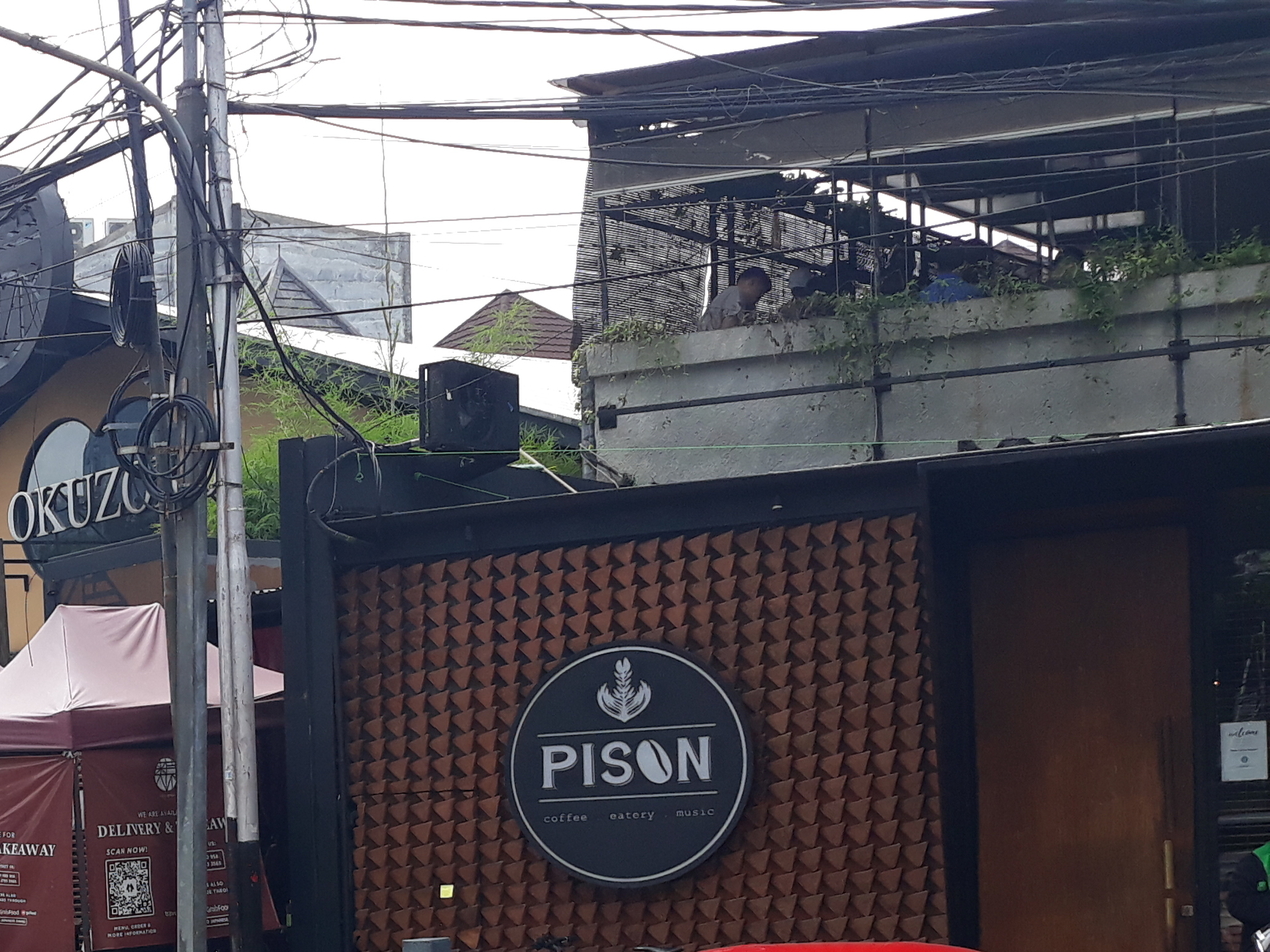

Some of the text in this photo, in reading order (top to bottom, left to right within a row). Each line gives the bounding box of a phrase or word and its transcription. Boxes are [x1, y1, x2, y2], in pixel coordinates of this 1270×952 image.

[138, 811, 147, 819] WE
[148, 810, 159, 818] ARE
[543, 806, 715, 824] coffee eatery music
[3, 831, 16, 839] FOR
[97, 822, 173, 838] DELIVERY &
[106, 846, 149, 856] SCAN NOW!
